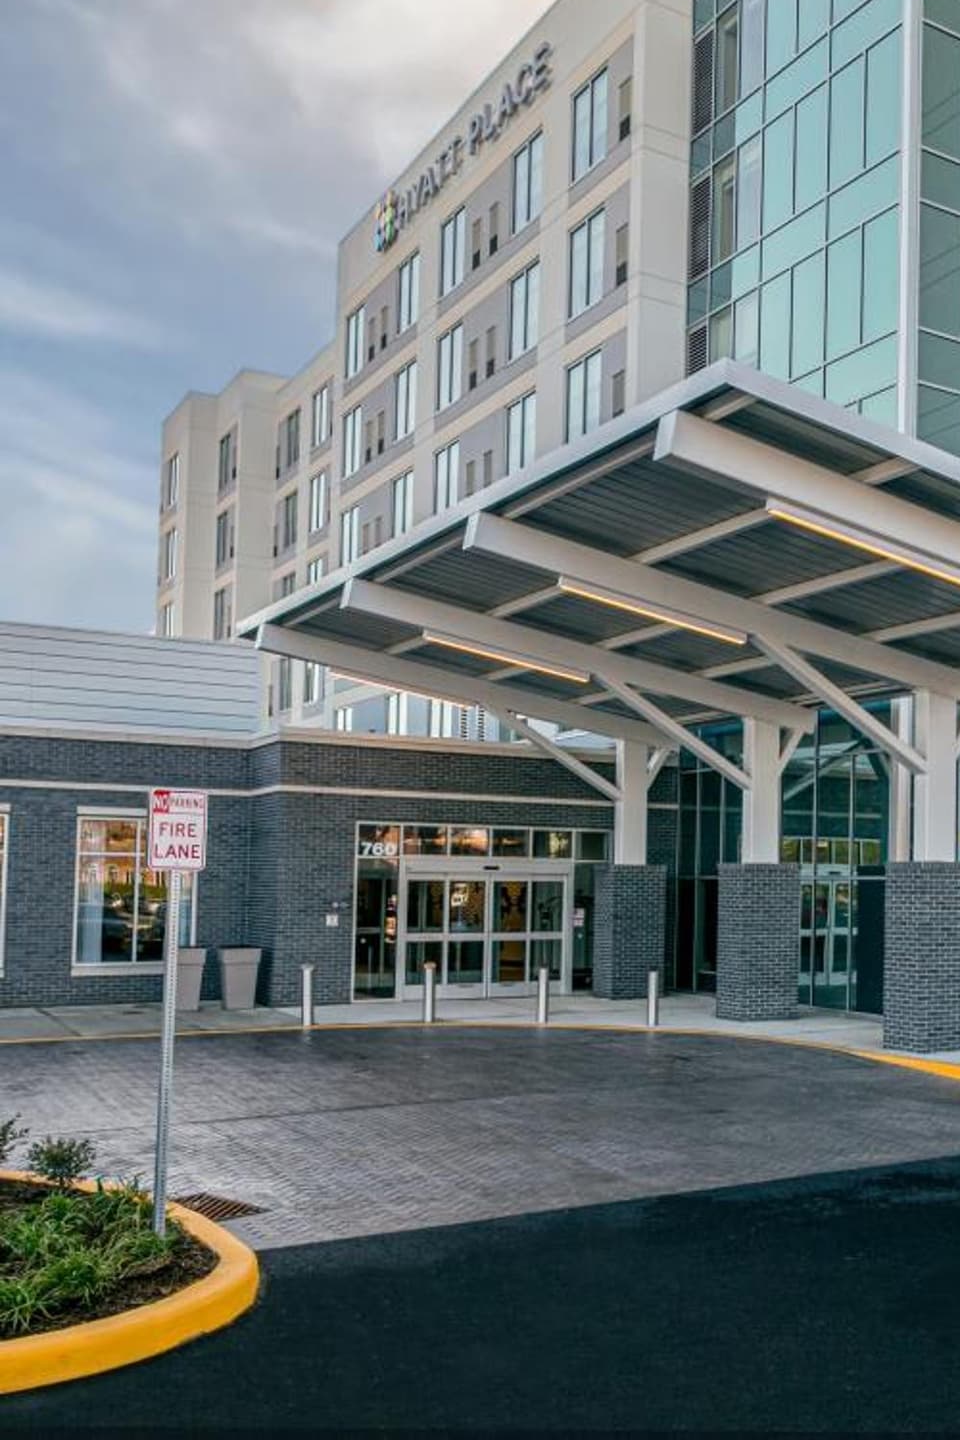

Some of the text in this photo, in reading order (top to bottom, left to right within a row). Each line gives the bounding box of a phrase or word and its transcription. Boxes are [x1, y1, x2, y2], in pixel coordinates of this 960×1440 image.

[395, 41, 553, 229] HYATT PLACE
[159, 822, 197, 837] FIRE
[155, 844, 200, 858] LANE
[361, 842, 397, 856] 760
